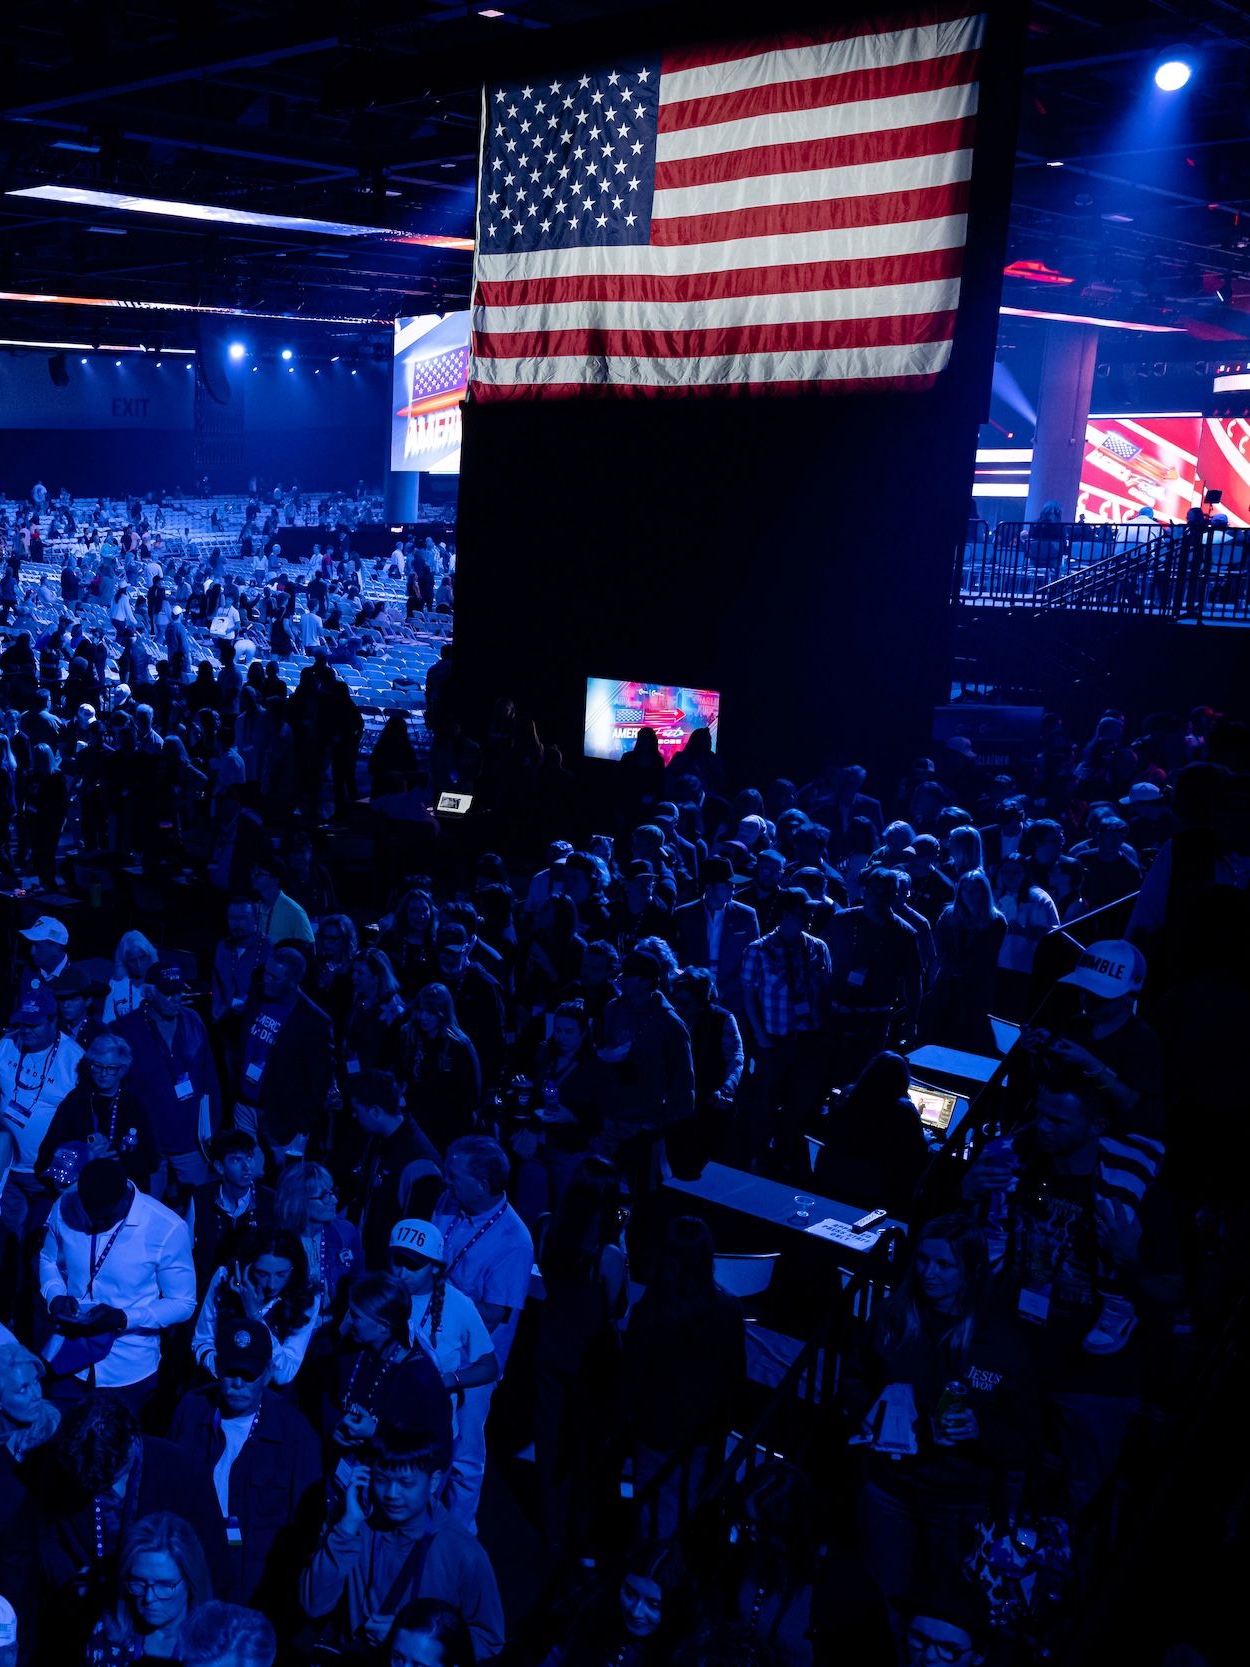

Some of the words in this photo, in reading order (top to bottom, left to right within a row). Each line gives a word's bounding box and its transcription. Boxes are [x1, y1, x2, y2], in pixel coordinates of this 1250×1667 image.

[112, 398, 151, 417] EXIT
[613, 728, 640, 739] AMER
[397, 1227, 427, 1248] 1776
[833, 1223, 872, 1239] APPRED
